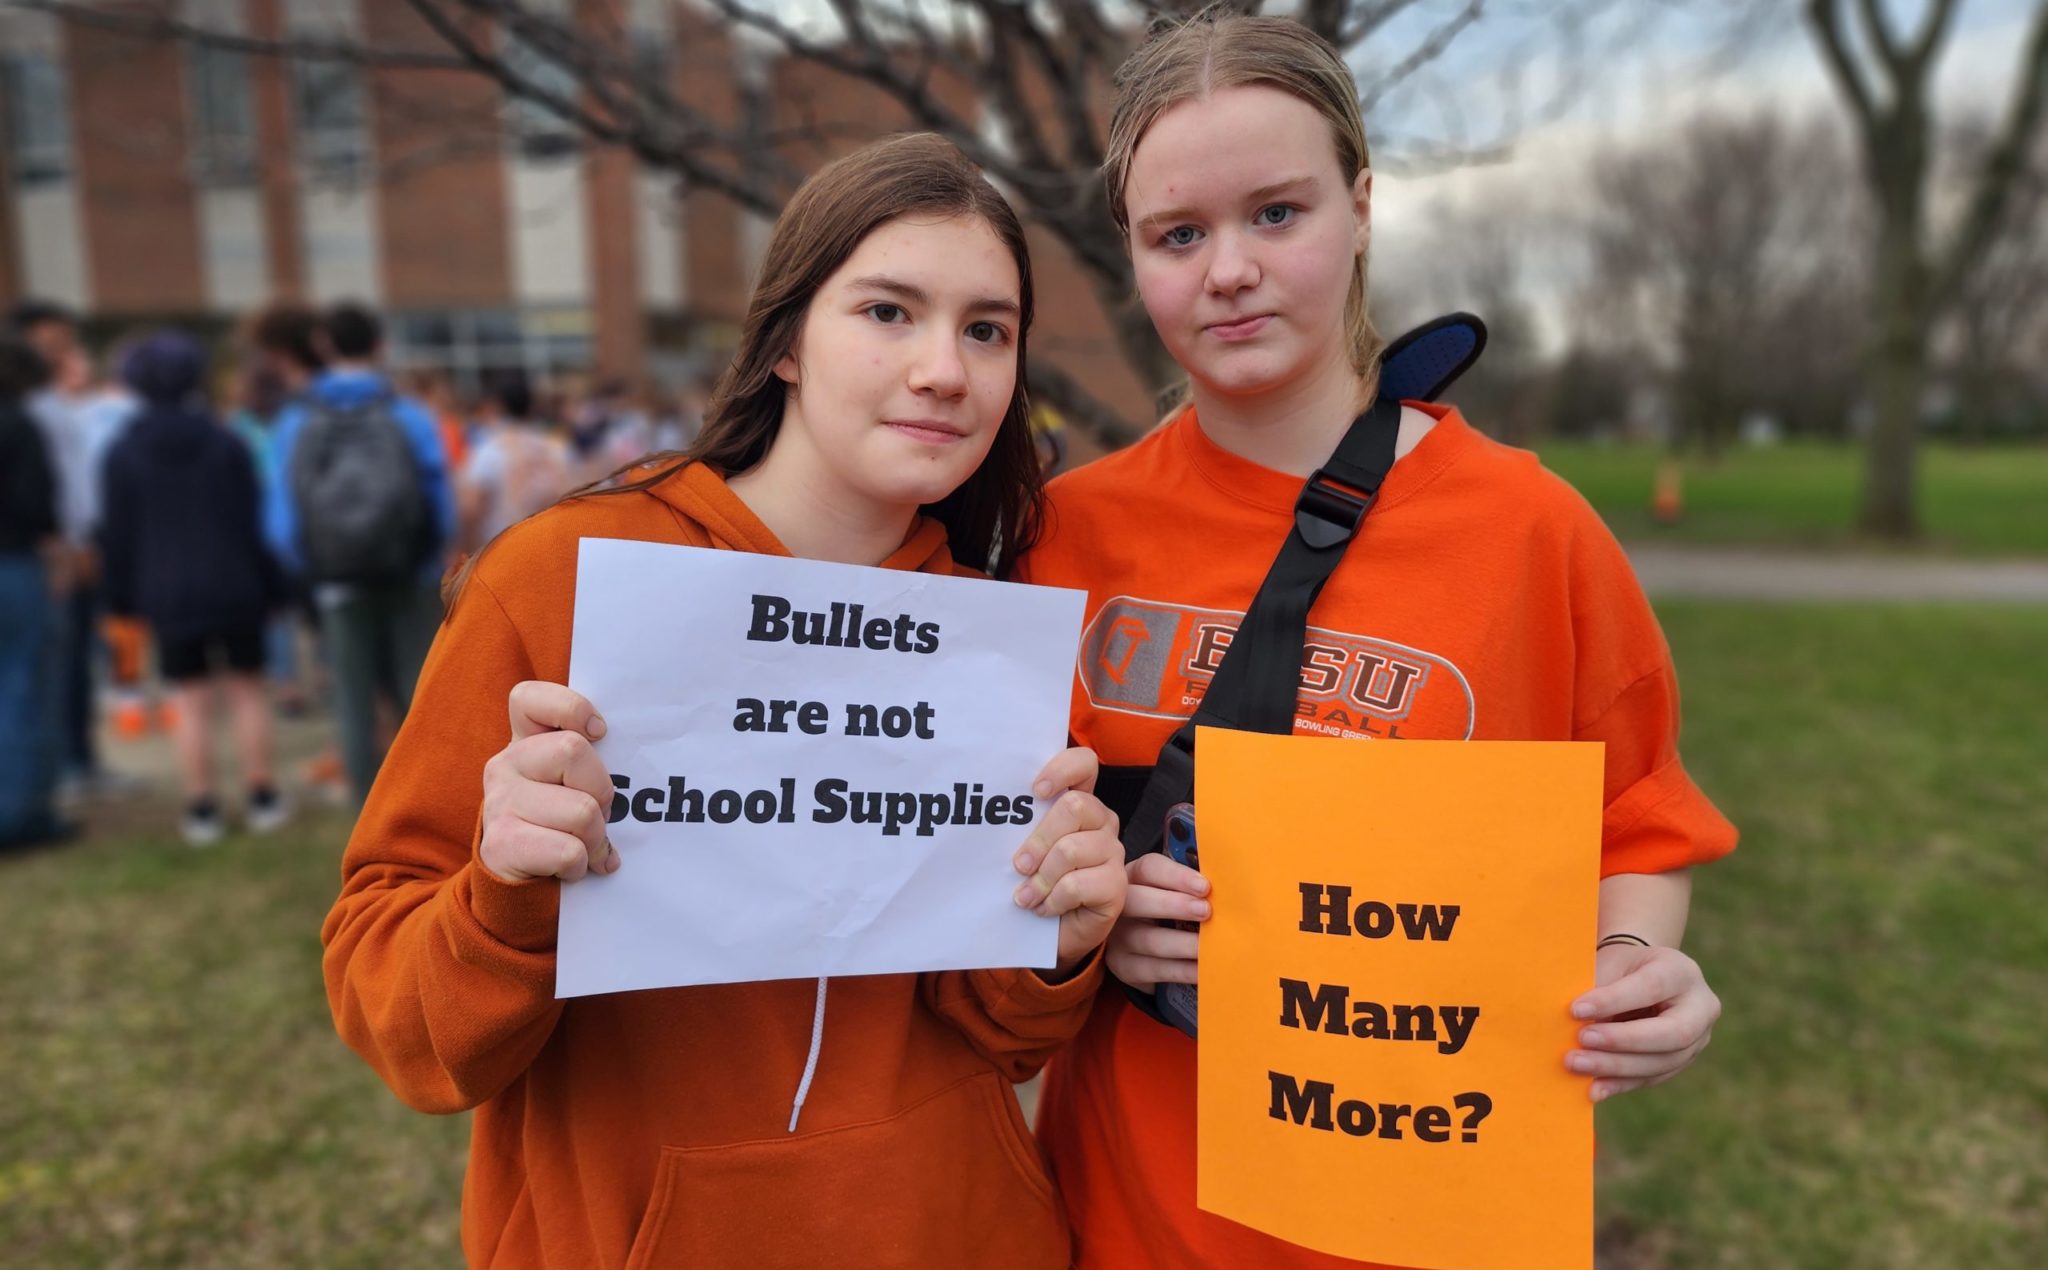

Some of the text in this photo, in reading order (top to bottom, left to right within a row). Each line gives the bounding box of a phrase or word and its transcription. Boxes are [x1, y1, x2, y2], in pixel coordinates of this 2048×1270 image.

[746, 594, 940, 654] Bullets
[1188, 623, 1419, 713] BSU
[732, 697, 935, 740] are not
[1185, 680, 1407, 739] FBALL
[1295, 718, 1340, 736] BOWLING
[605, 773, 1034, 837] School Supplies
[1298, 882, 1461, 942] How
[1279, 977, 1481, 1056] Many
[1268, 1070, 1493, 1143] More?
